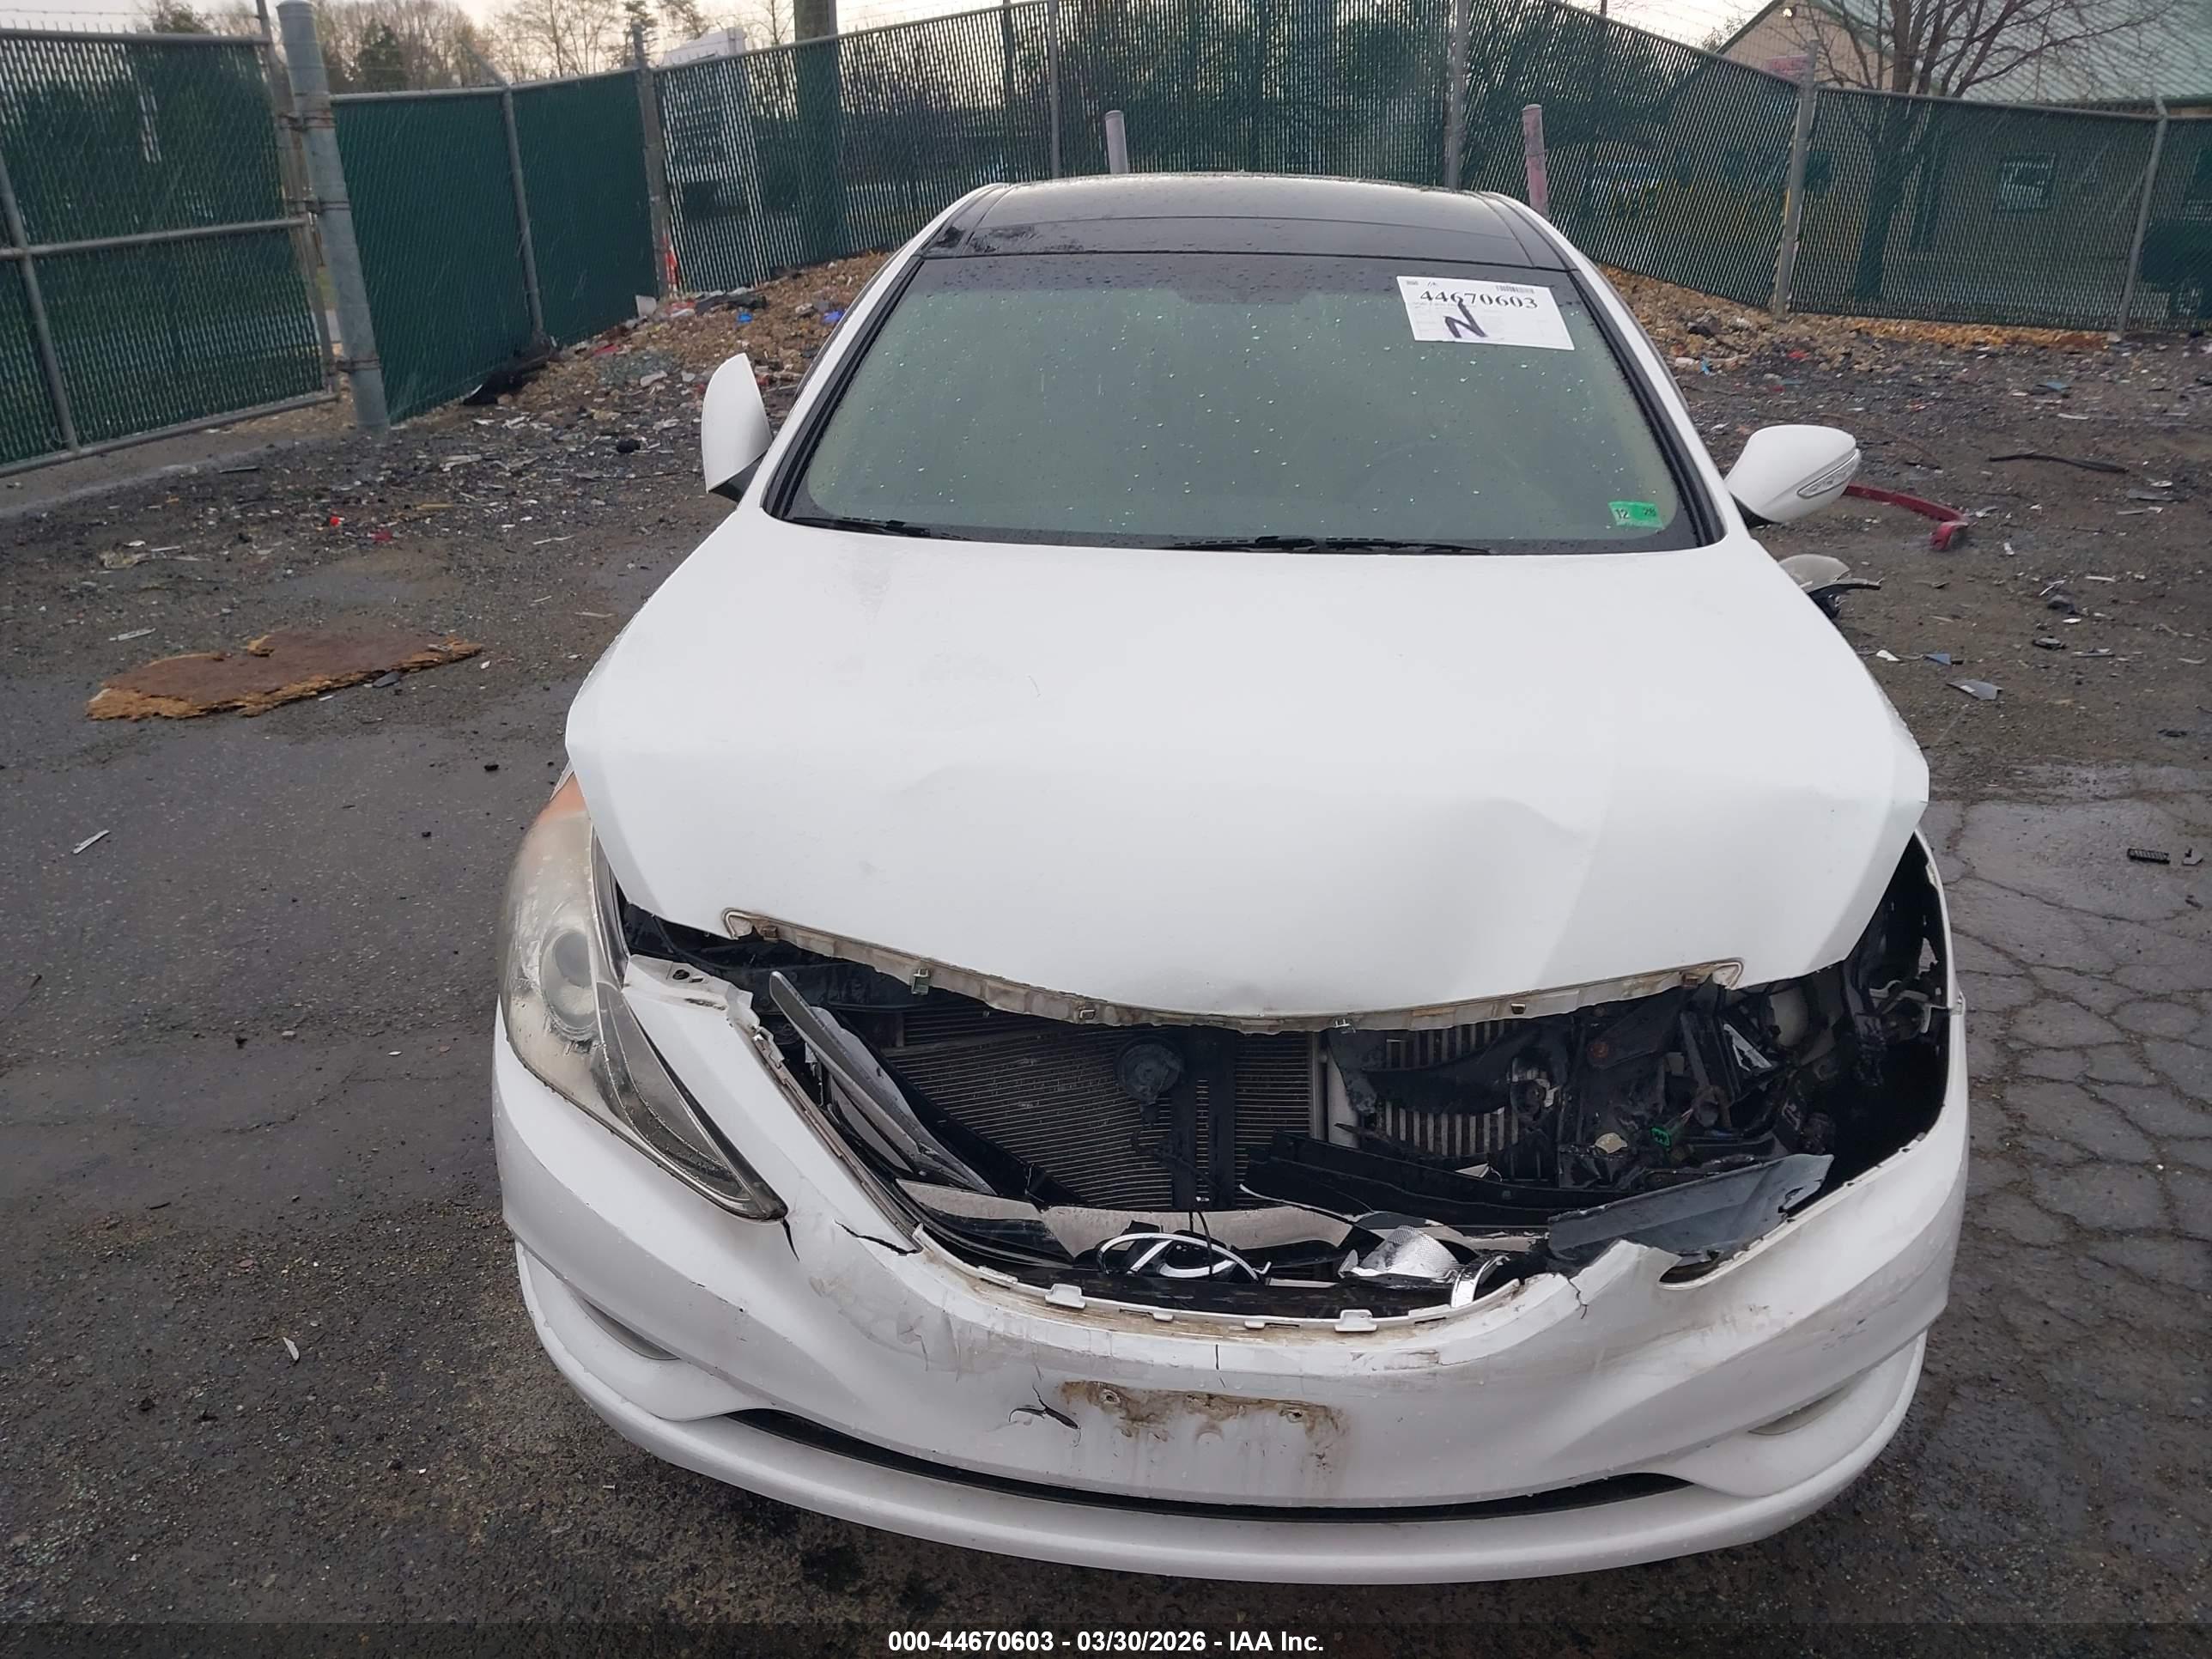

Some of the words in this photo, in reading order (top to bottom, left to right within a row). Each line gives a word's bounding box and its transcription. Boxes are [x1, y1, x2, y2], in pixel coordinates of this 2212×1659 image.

[1419, 289, 1539, 310] 44670603
[1443, 300, 1489, 338] N
[1614, 508, 1630, 520] 12
